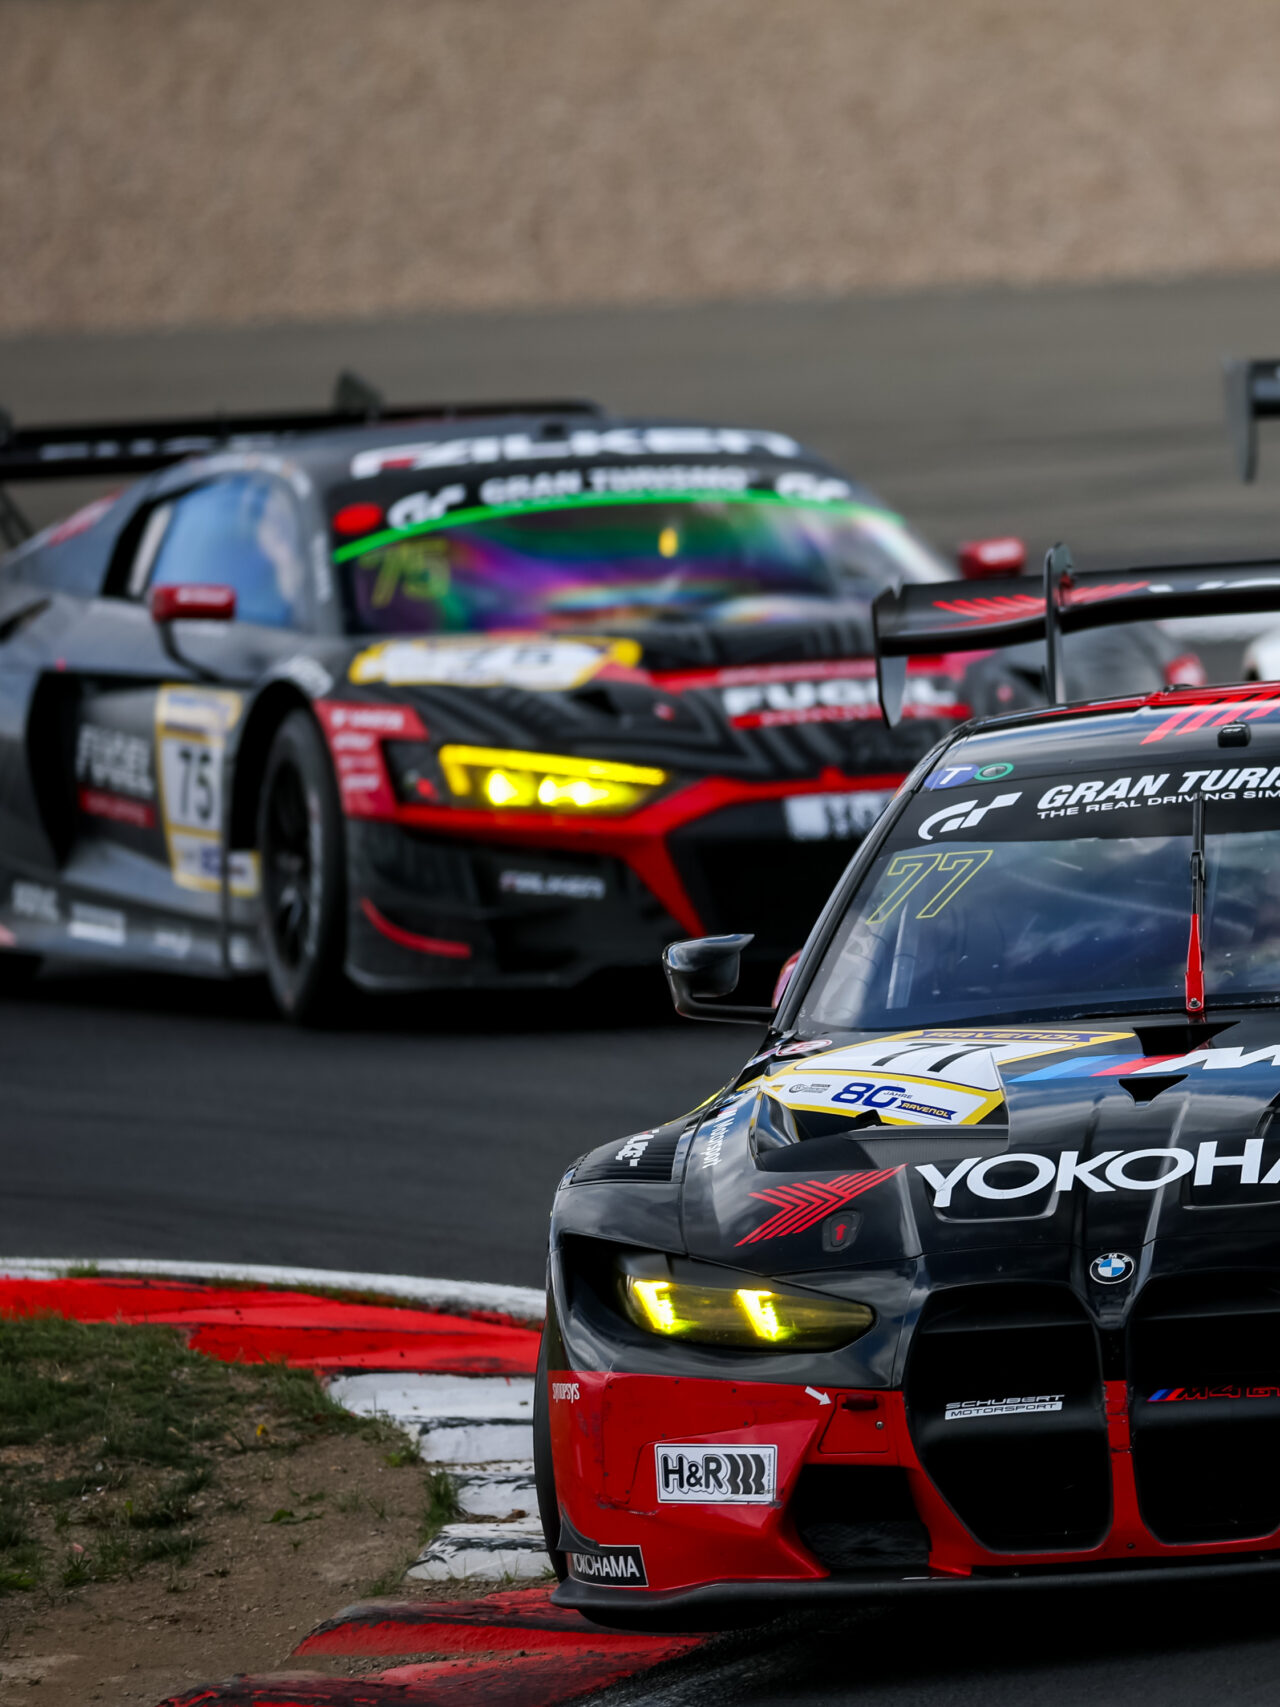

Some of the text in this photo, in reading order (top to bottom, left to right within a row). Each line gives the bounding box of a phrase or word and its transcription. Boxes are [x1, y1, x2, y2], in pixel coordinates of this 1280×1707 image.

[178, 745, 214, 823] 75
[1037, 773, 1170, 811] GRAN
[1037, 806, 1080, 821] THE
[1086, 799, 1141, 813] REAL
[865, 849, 994, 925] 77
[925, 1031, 1087, 1043] RAVENOL
[871, 1042, 1008, 1074] 77
[883, 1090, 913, 1101] JAHRE
[901, 1102, 950, 1119] RAVENOL
[702, 1117, 736, 1169] Motorsport
[945, 1394, 1065, 1410] SCHUBERT
[950, 1403, 1060, 1419] MOTORSPORT
[661, 1454, 728, 1492] H&R
[572, 1553, 641, 1578] YOKOHAMA
